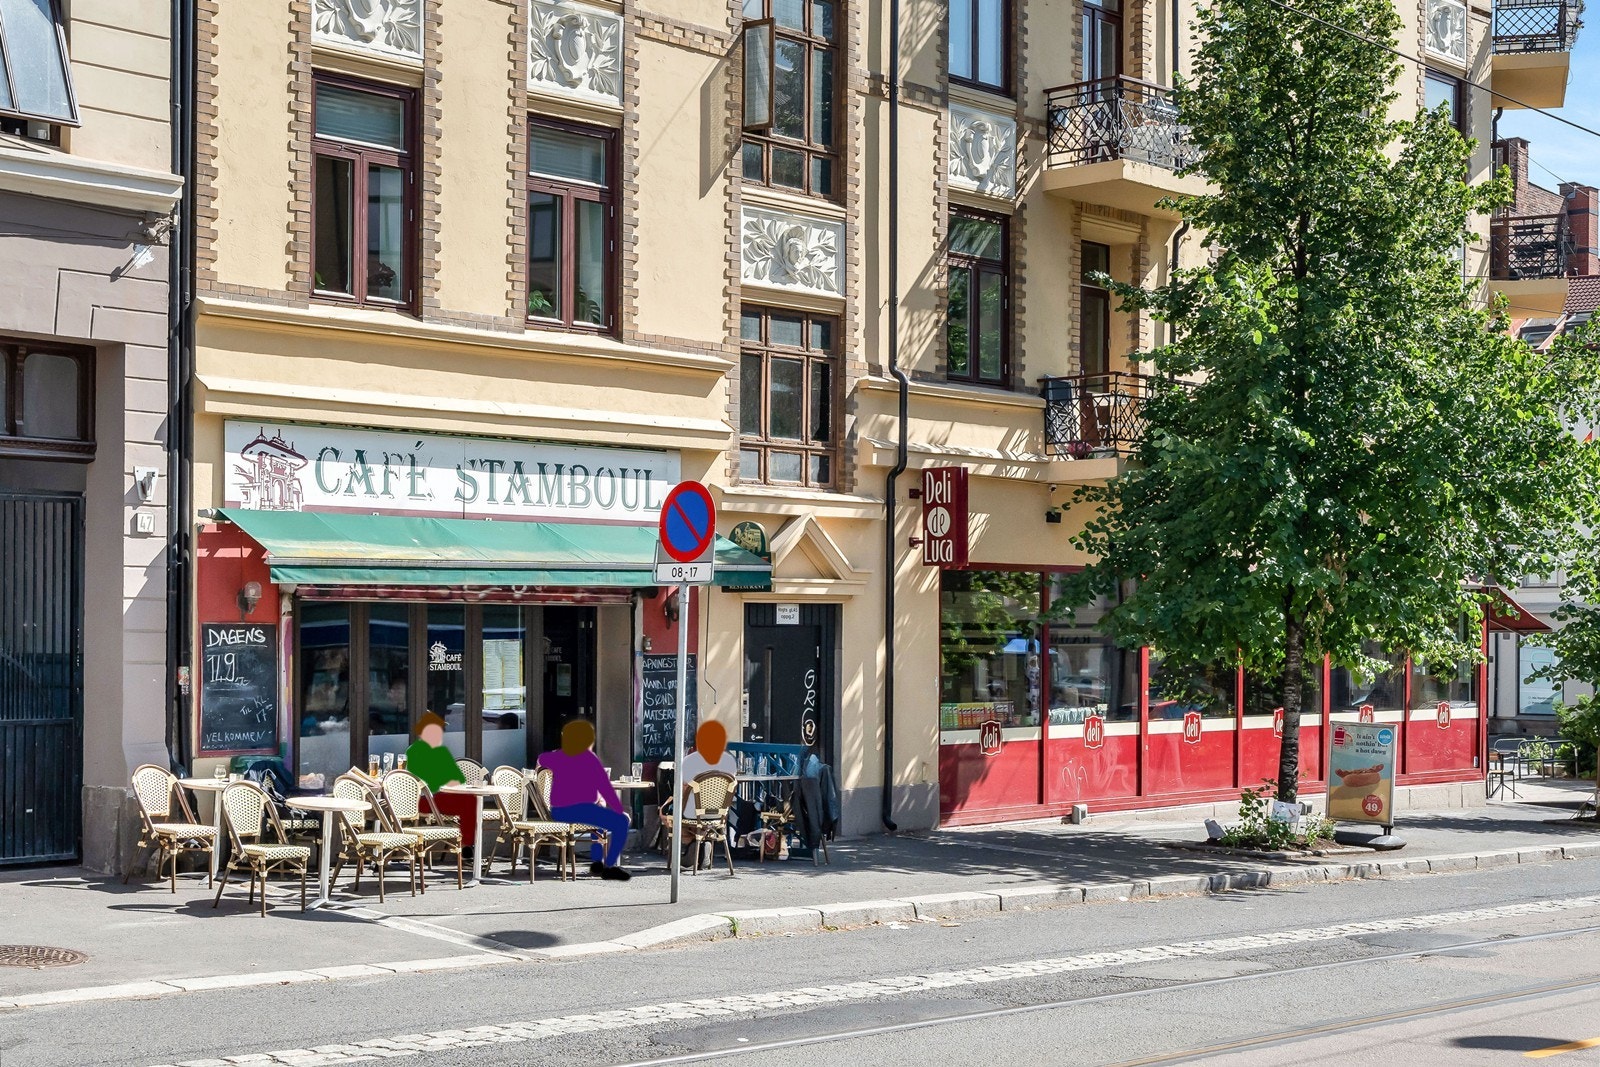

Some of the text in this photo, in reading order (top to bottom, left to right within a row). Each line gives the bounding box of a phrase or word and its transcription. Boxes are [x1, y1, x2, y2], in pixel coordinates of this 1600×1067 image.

[315, 441, 663, 513] CAFÉ STAMBOUL
[926, 470, 951, 504] Deli
[140, 515, 153, 532] 47
[931, 507, 945, 535] de
[925, 530, 953, 563] Luca
[671, 566, 698, 578] 08-17
[206, 628, 267, 647] DAGENS
[1087, 722, 1100, 742] deli
[1186, 717, 1199, 737] deli
[984, 727, 998, 749] deli
